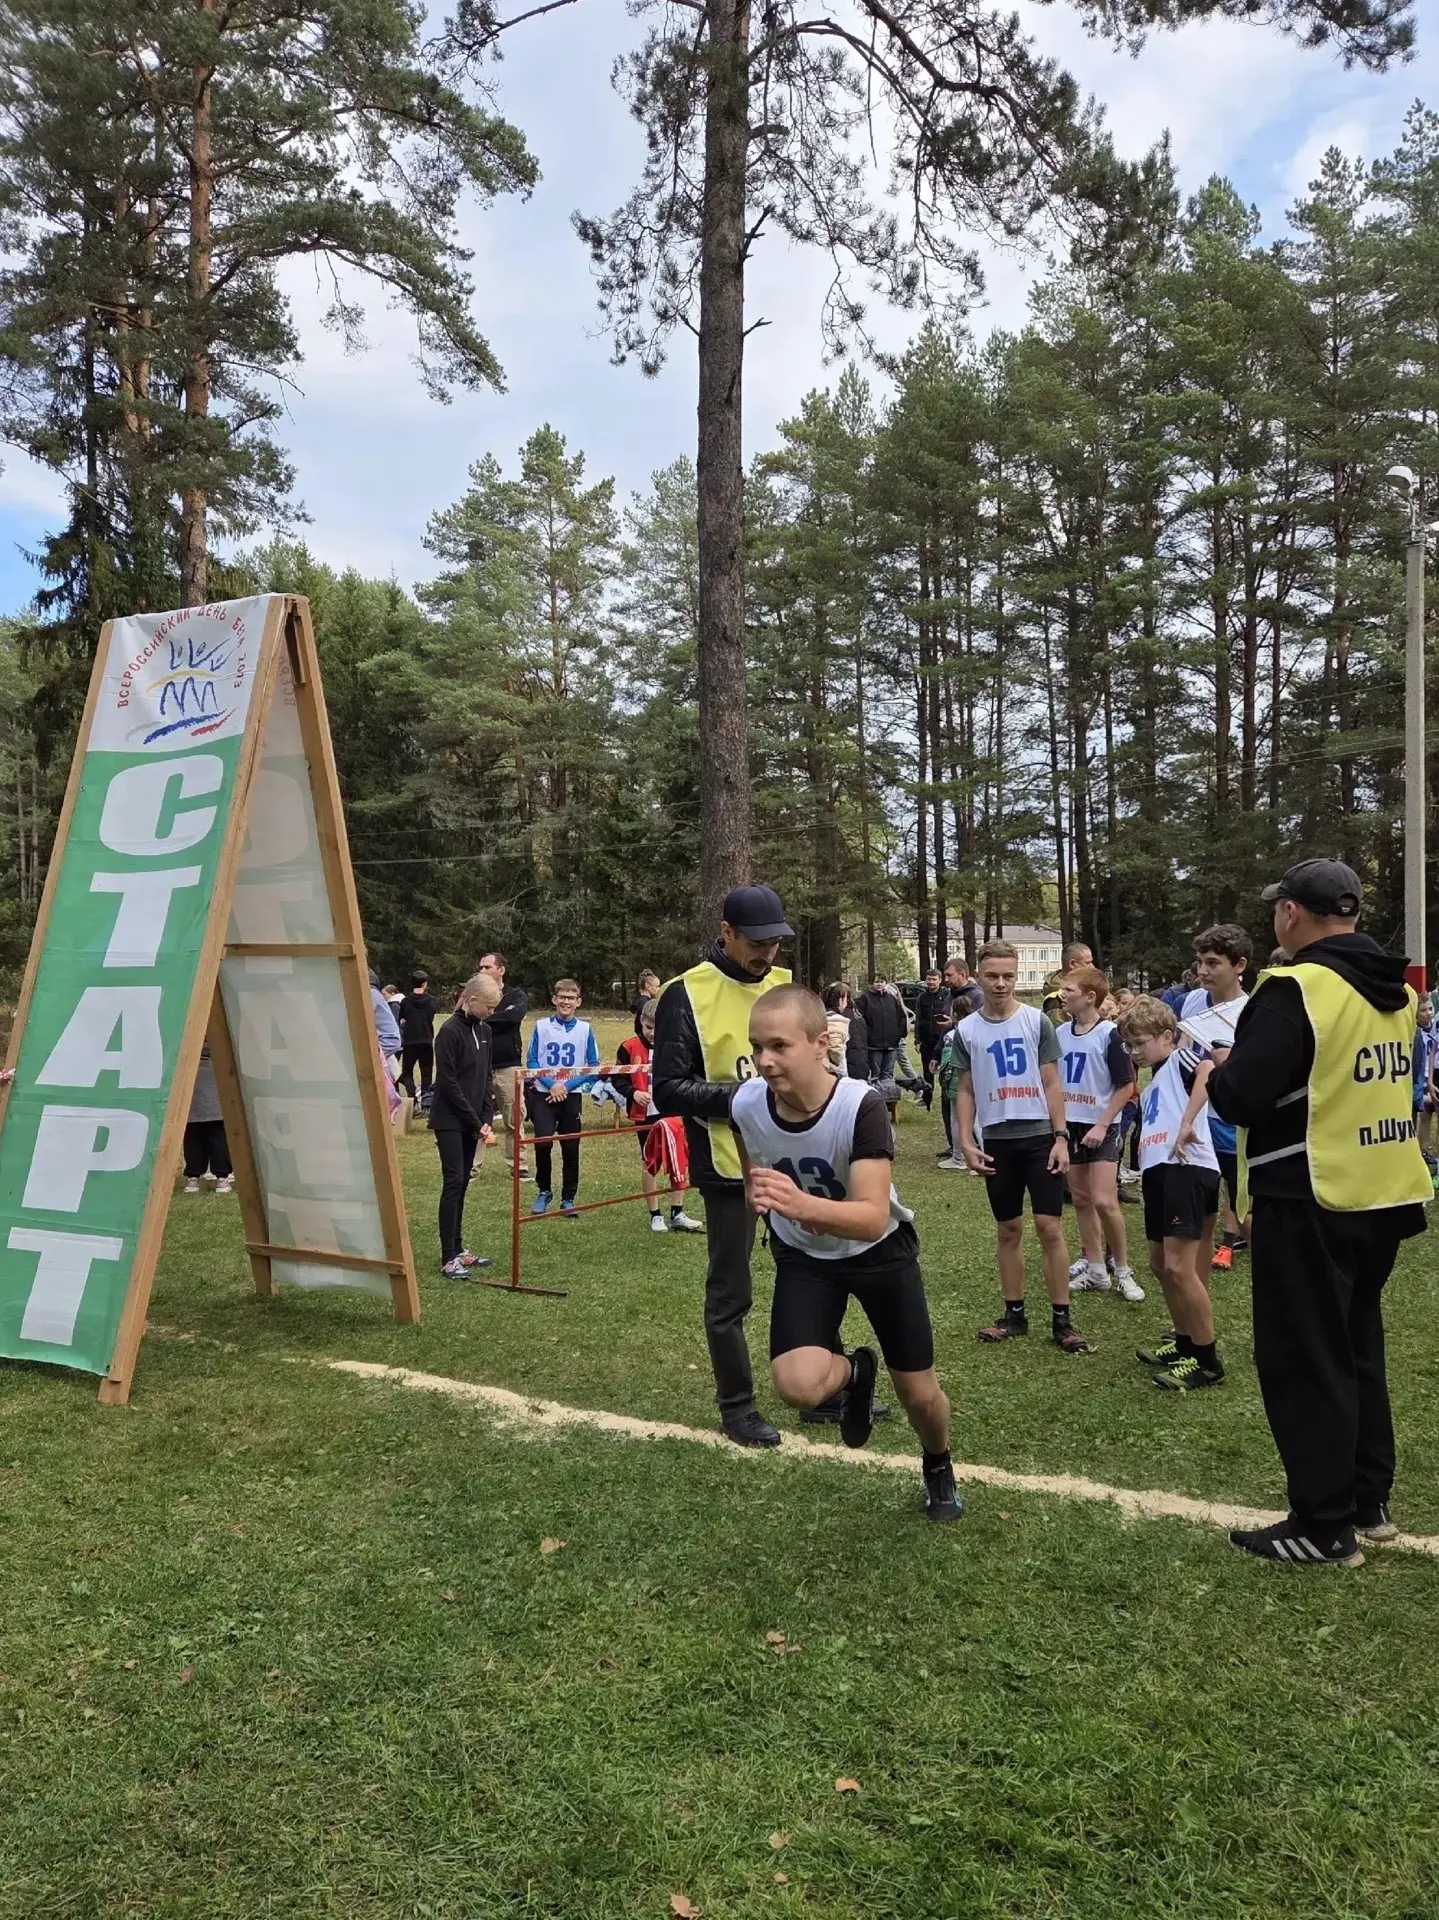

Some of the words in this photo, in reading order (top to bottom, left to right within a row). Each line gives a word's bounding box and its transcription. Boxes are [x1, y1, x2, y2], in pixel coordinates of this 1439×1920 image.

[197, 604, 227, 621] ДЕНЬ
[7, 754, 224, 1346] СТАРТ
[546, 1042, 576, 1067] 33
[986, 1037, 1027, 1078] 15
[1064, 1051, 1087, 1083] 17
[1353, 1041, 1413, 1084] СУДЬ
[772, 1157, 847, 1201] 13
